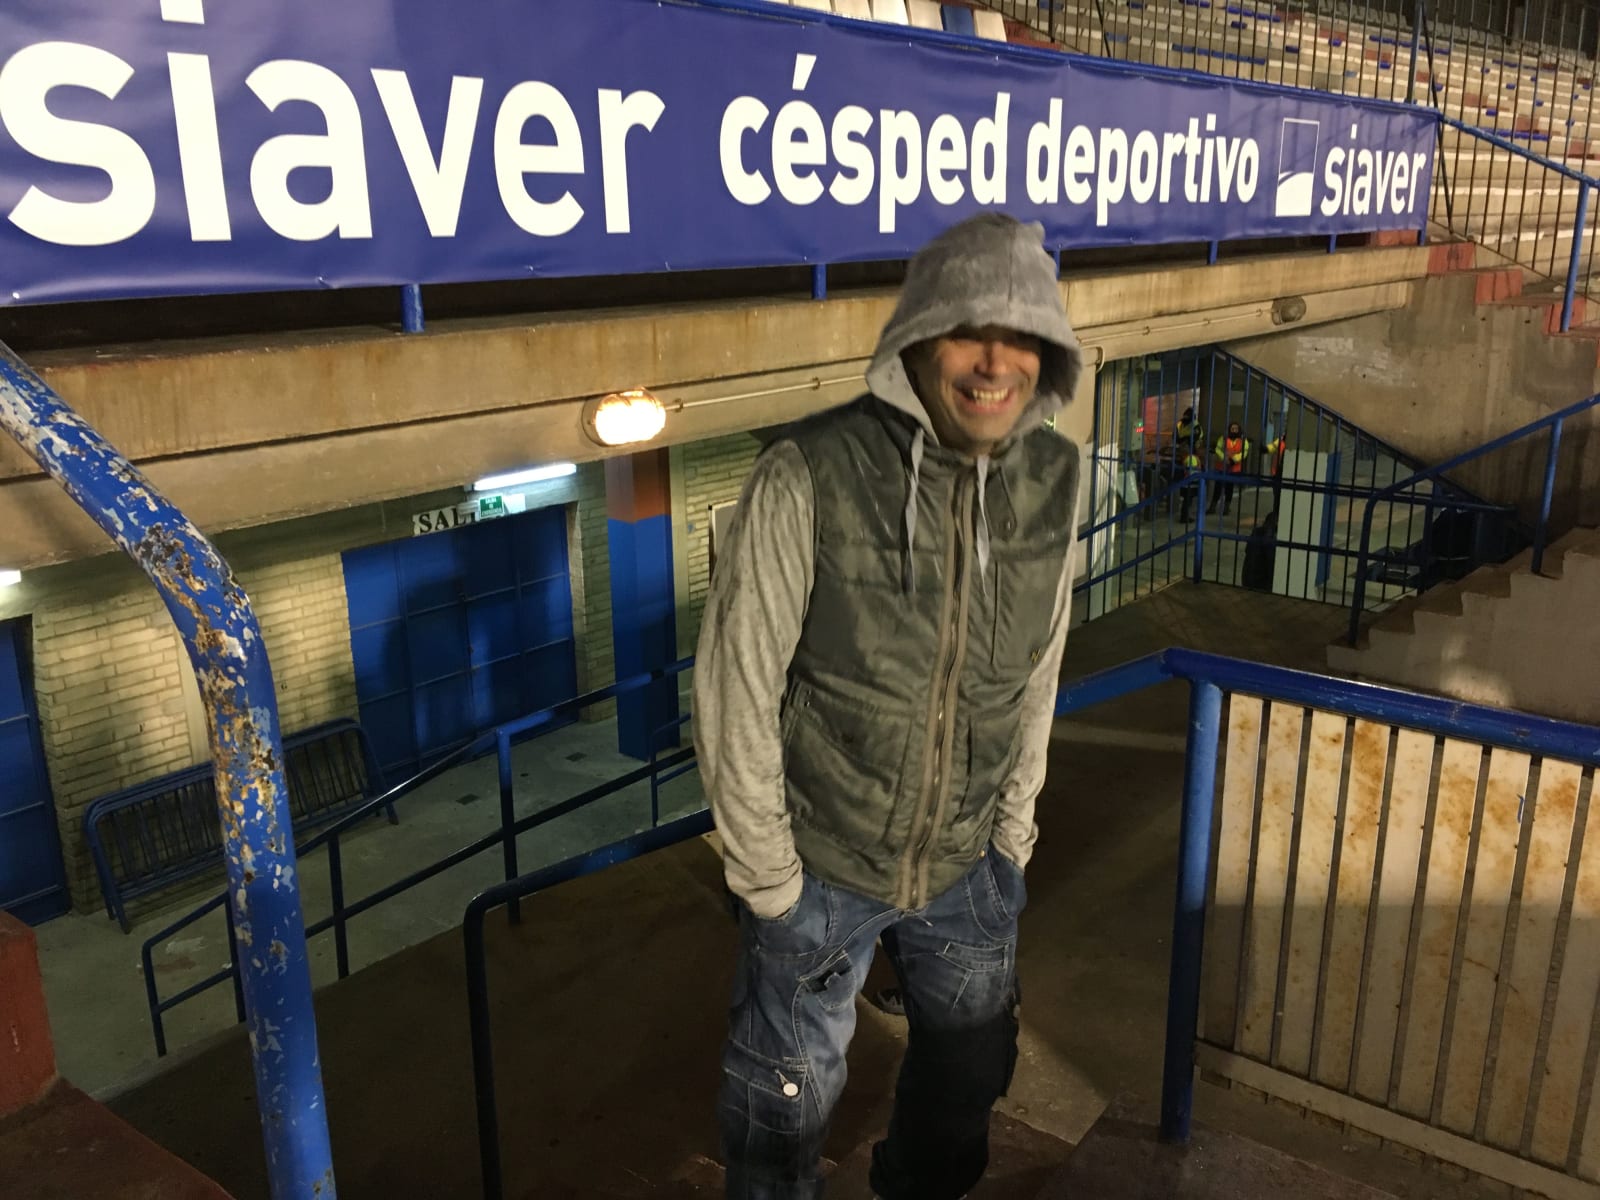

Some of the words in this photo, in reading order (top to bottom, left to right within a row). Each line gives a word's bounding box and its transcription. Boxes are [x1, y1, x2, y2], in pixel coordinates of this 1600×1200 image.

[0, 0, 666, 246] siaver
[719, 53, 1011, 233] césped
[1026, 98, 1259, 226] deportivo
[1320, 124, 1427, 216] siaver
